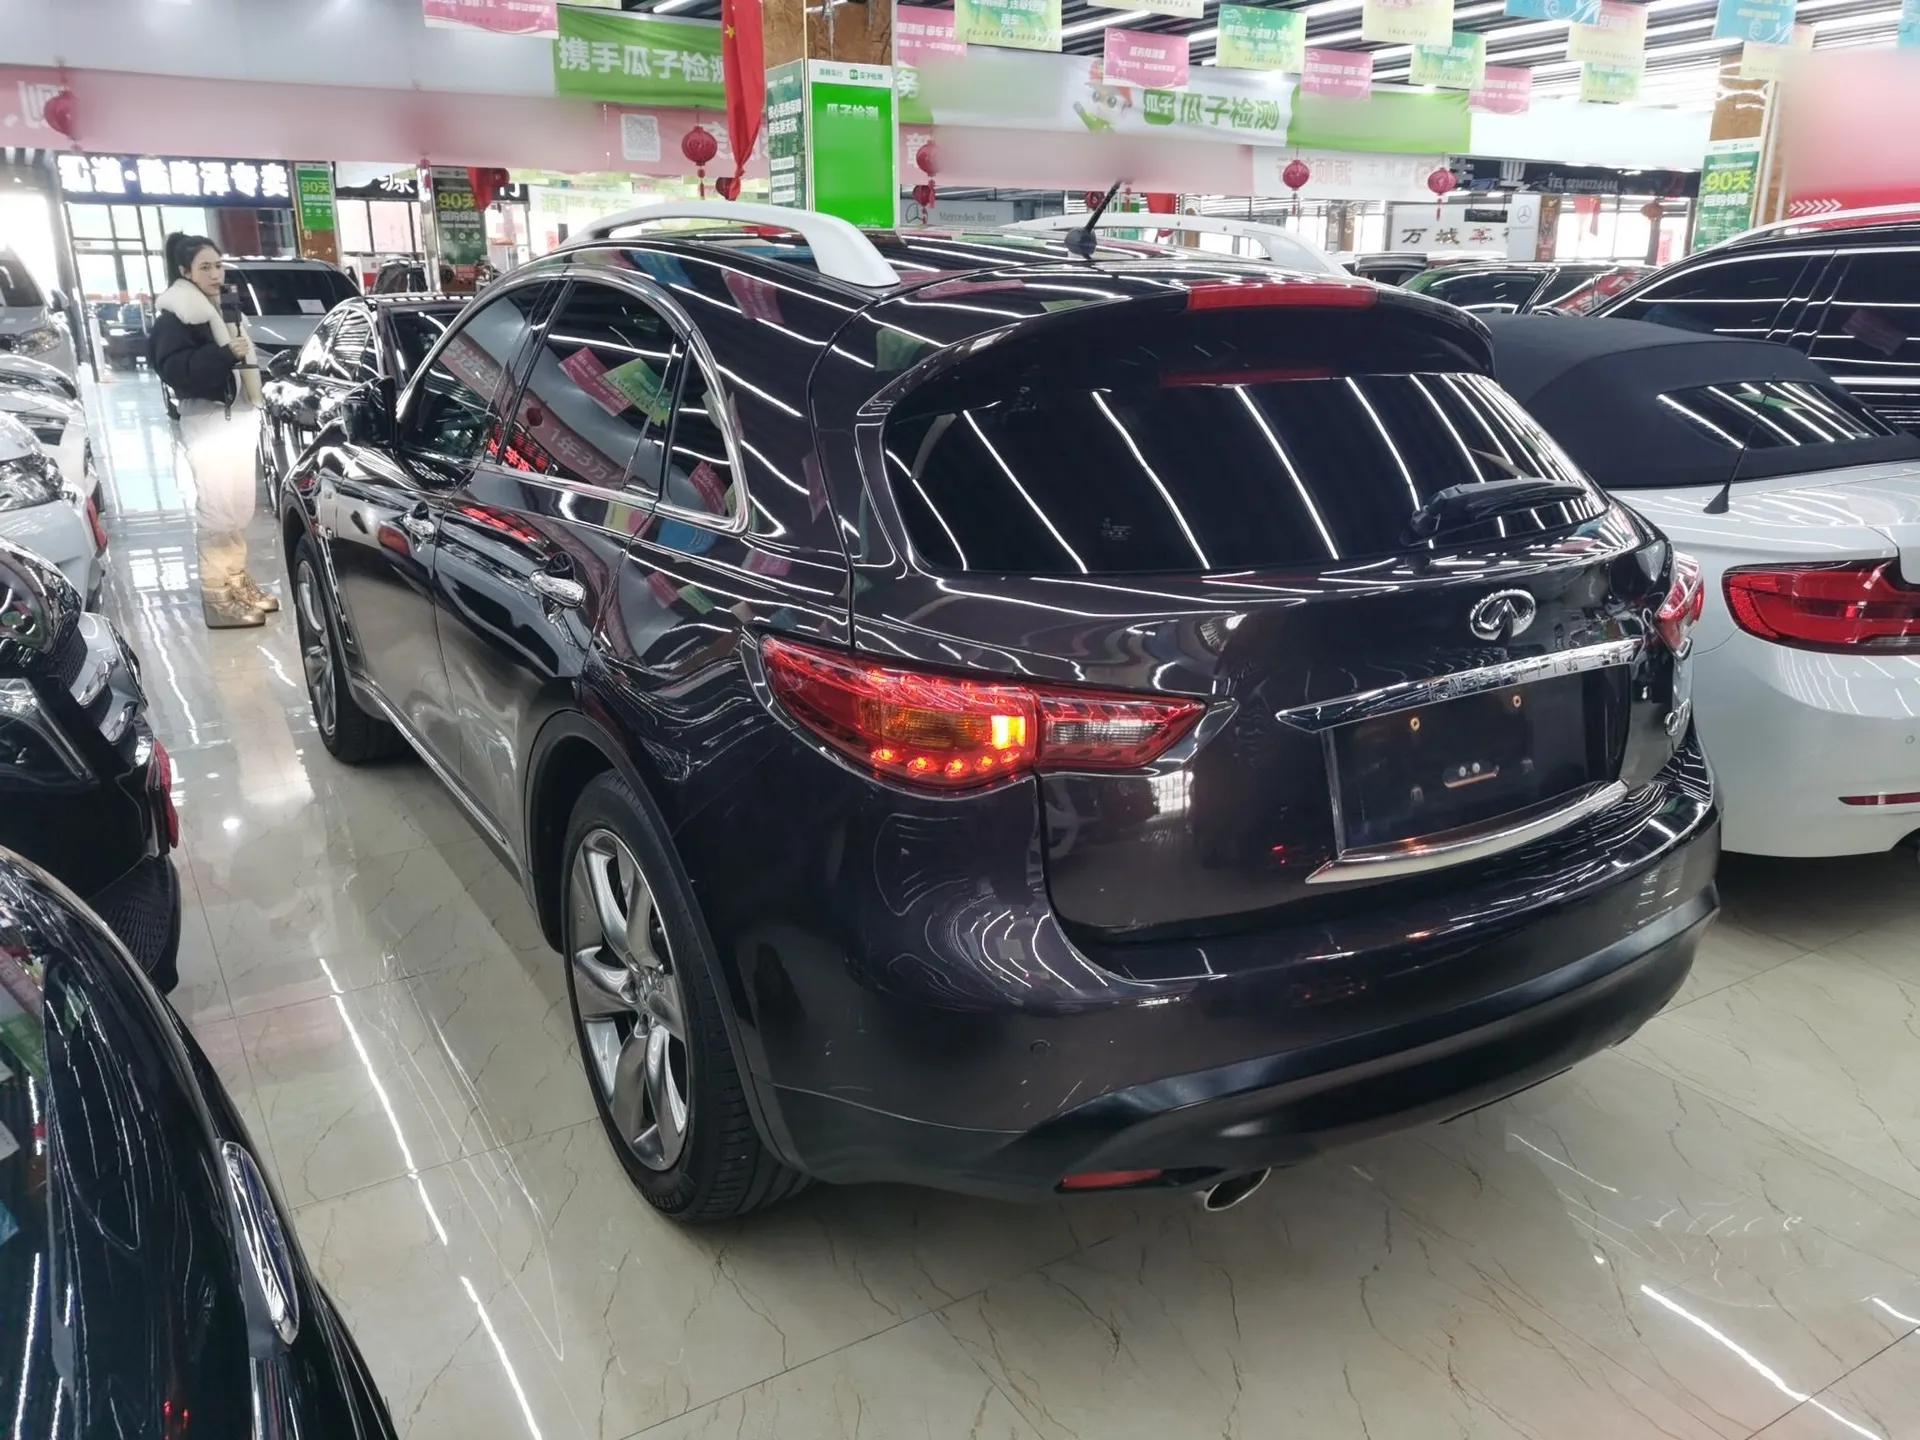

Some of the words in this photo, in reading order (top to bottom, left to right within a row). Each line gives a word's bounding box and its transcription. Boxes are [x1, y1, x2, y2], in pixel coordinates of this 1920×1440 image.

[1181, 92, 1281, 131] 瓜子检测
[1706, 169, 1751, 192] 90天
